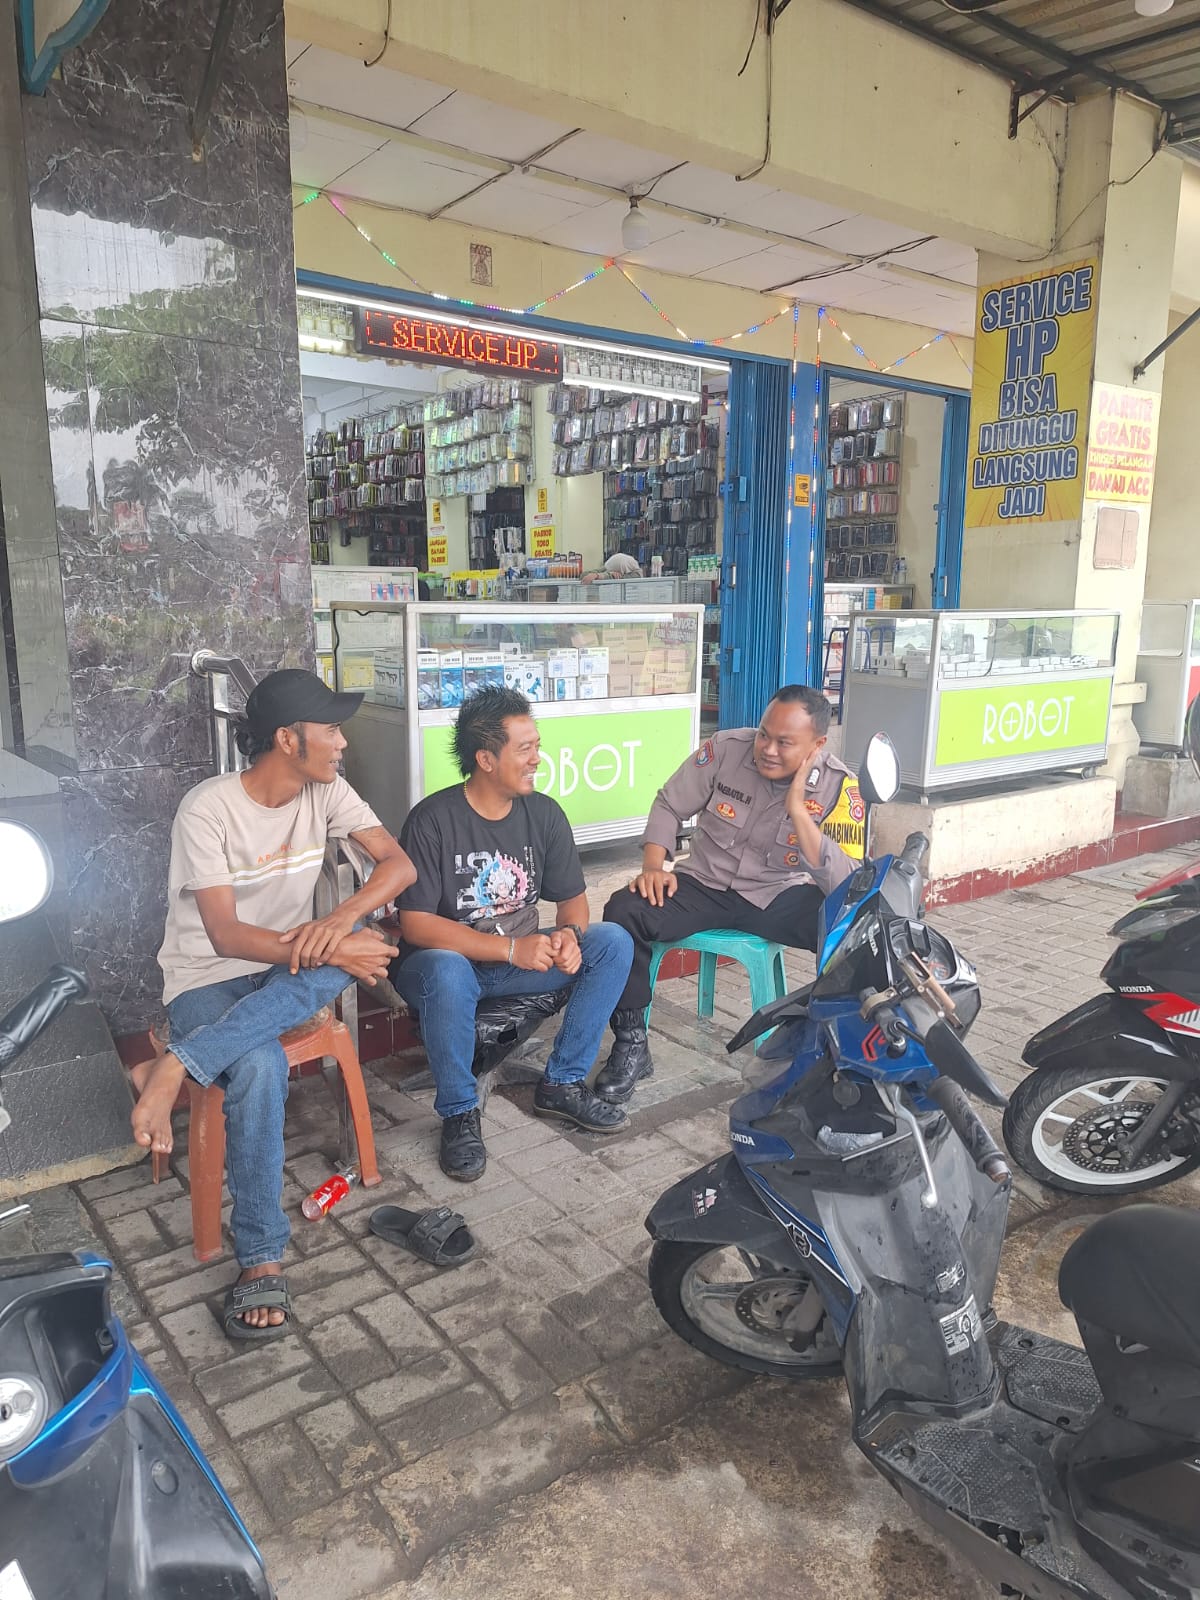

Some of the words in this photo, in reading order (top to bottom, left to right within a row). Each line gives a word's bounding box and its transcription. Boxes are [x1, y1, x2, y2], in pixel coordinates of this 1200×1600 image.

[982, 267, 1093, 332] SERVICE
[393, 319, 498, 363] SERVICE
[505, 338, 538, 369] HP
[1005, 318, 1059, 382] HP
[999, 374, 1058, 420] BISA
[979, 410, 1078, 454] DITUNGGU
[1096, 420, 1152, 451] GRATIS
[973, 446, 1078, 488] LANGSUNG
[1127, 475, 1150, 496] ACC
[998, 485, 1046, 518] JADI
[982, 695, 1076, 745] ROBOT
[534, 740, 642, 797] OBOT
[1118, 985, 1156, 993] HONDA
[729, 1131, 756, 1146] ONDA
